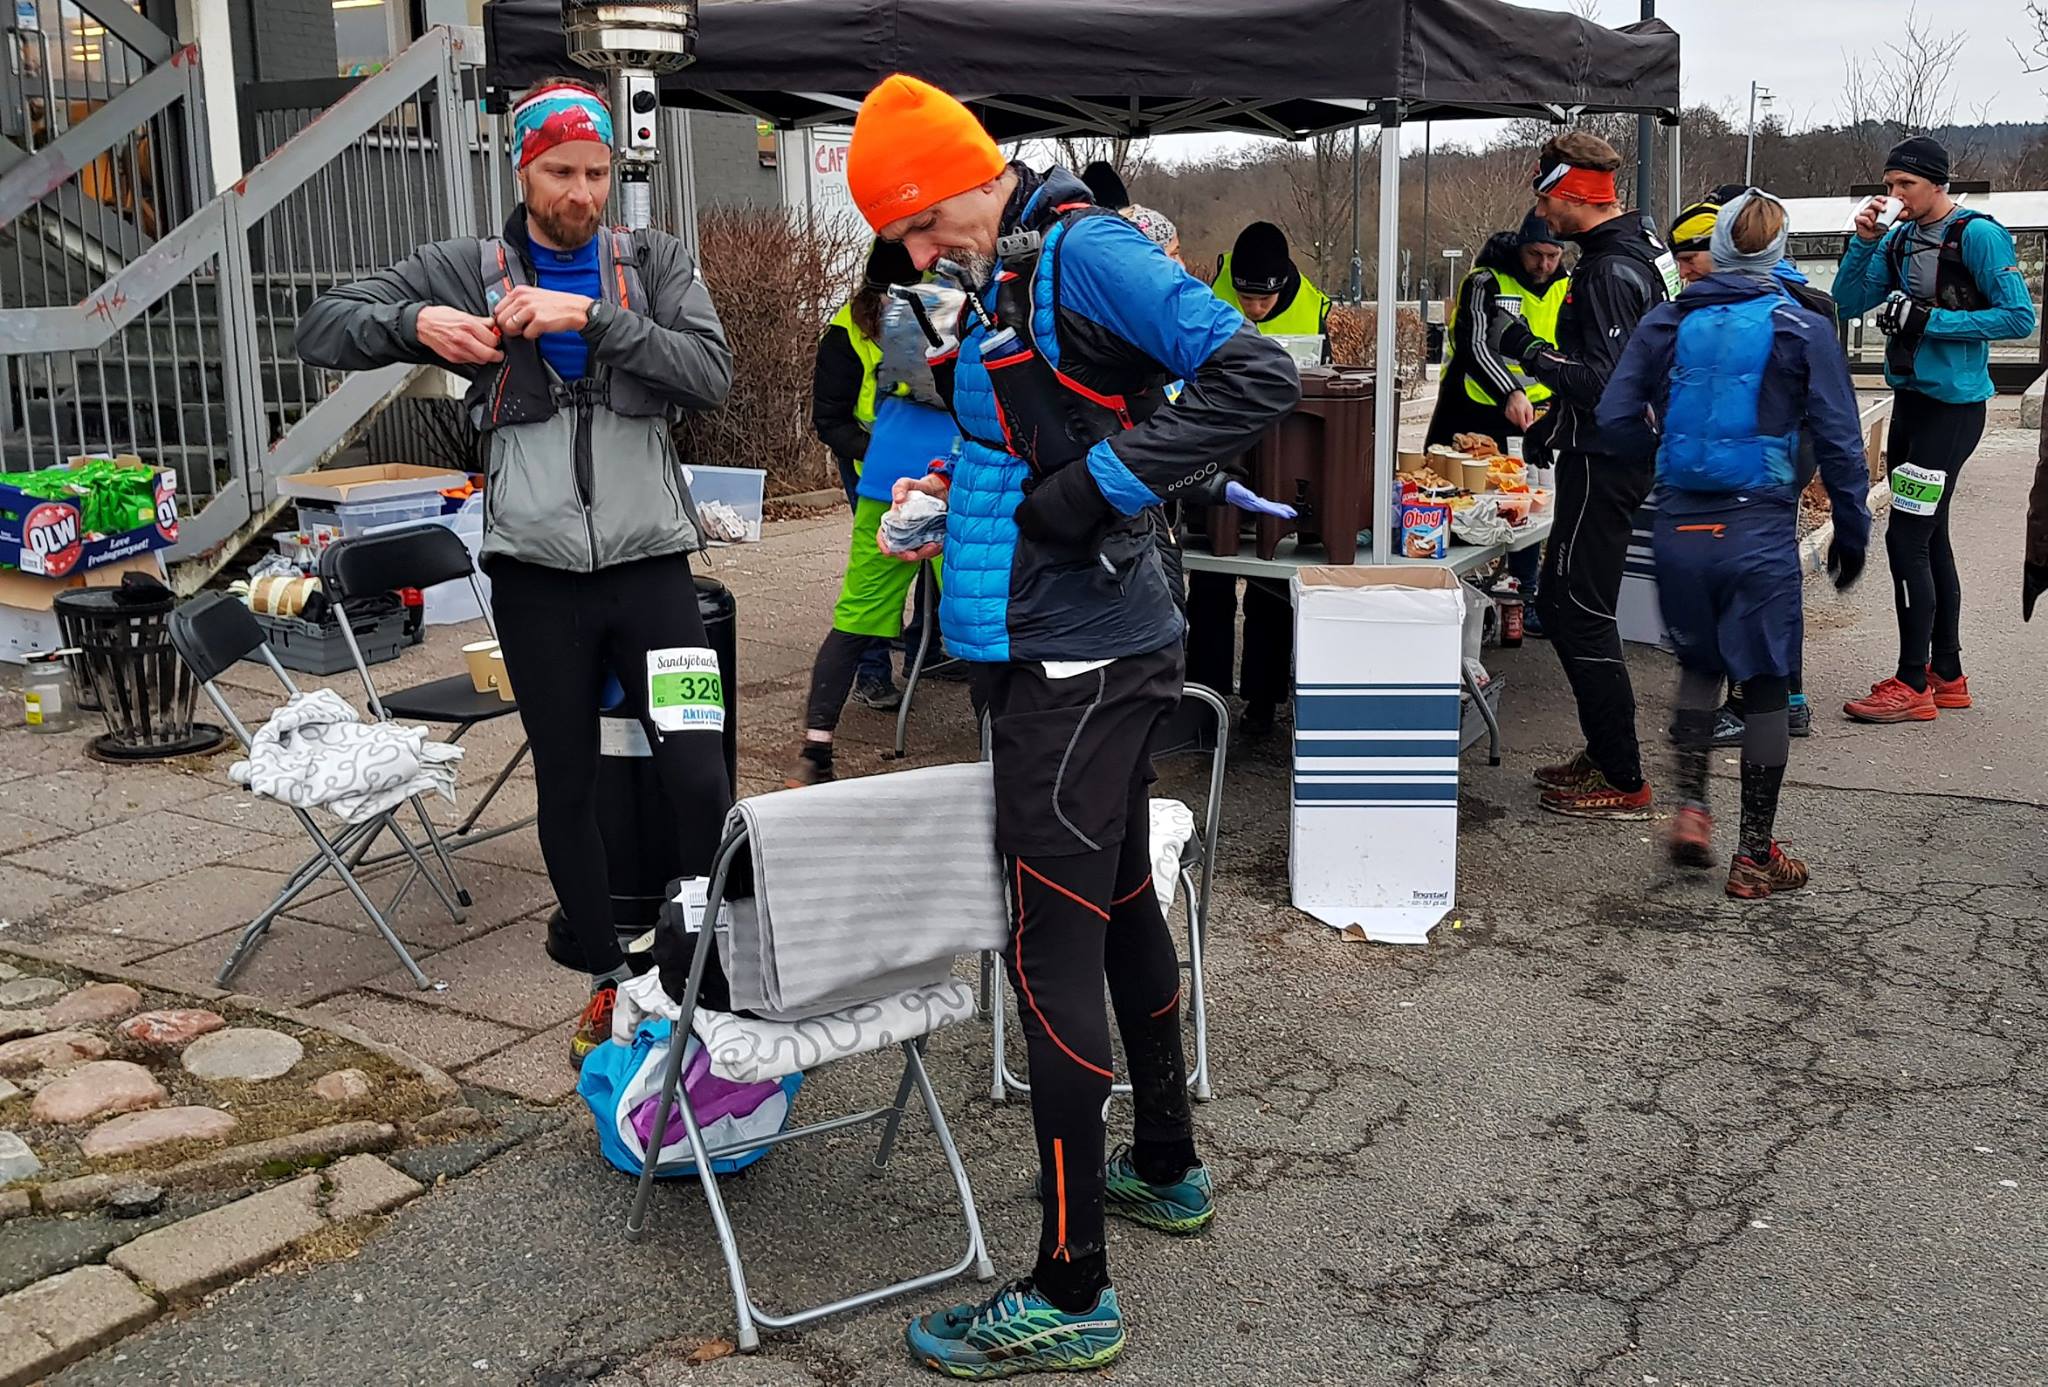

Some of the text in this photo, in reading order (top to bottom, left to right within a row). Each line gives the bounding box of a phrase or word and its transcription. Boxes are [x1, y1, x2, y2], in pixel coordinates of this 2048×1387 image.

[814, 145, 849, 174] CAF
[1898, 479, 1927, 499] 357
[1402, 507, 1442, 530] O'boy
[29, 515, 77, 556] OLW
[680, 677, 721, 702] 329
[1571, 796, 1625, 809] SCOTT
